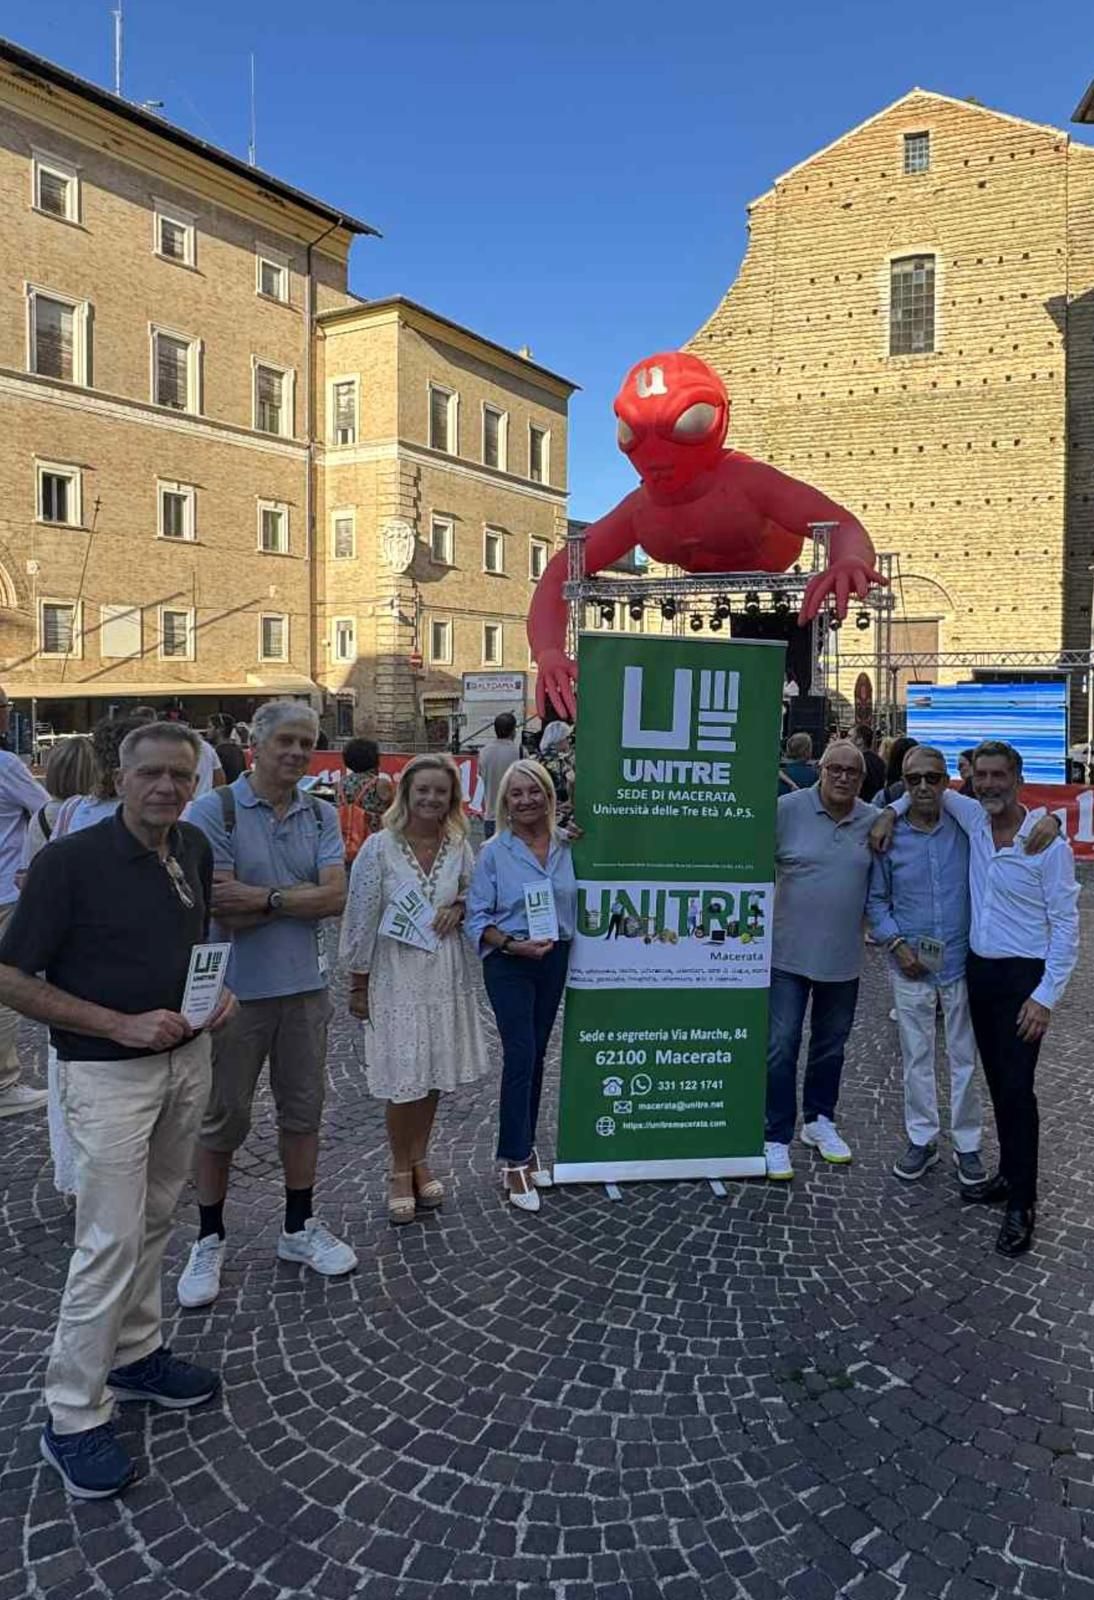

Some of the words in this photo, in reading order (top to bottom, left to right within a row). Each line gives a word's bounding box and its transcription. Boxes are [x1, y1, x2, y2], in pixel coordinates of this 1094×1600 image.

[623, 758, 731, 785] UNITRE
[617, 788, 648, 800] SEDE
[651, 789, 665, 801] DI
[668, 790, 737, 802] MACERATA
[593, 803, 649, 816] Università
[652, 804, 679, 816] delle
[682, 806, 700, 817] Tre
[702, 806, 719, 817] Età
[724, 807, 755, 818] A.P.S.
[576, 888, 766, 938] UNITRE
[710, 951, 764, 962] Macerata
[579, 1030, 605, 1043] Sede
[607, 1032, 614, 1041] e
[616, 1030, 669, 1044] segreteria
[671, 1029, 688, 1041] Via
[690, 1028, 732, 1042] Marche,
[734, 1028, 748, 1040] 84
[595, 1050, 647, 1066] 62100
[655, 1050, 732, 1065] Macerata
[657, 1080, 676, 1091] 331
[680, 1080, 697, 1091] 122
[700, 1080, 723, 1090] 1741
